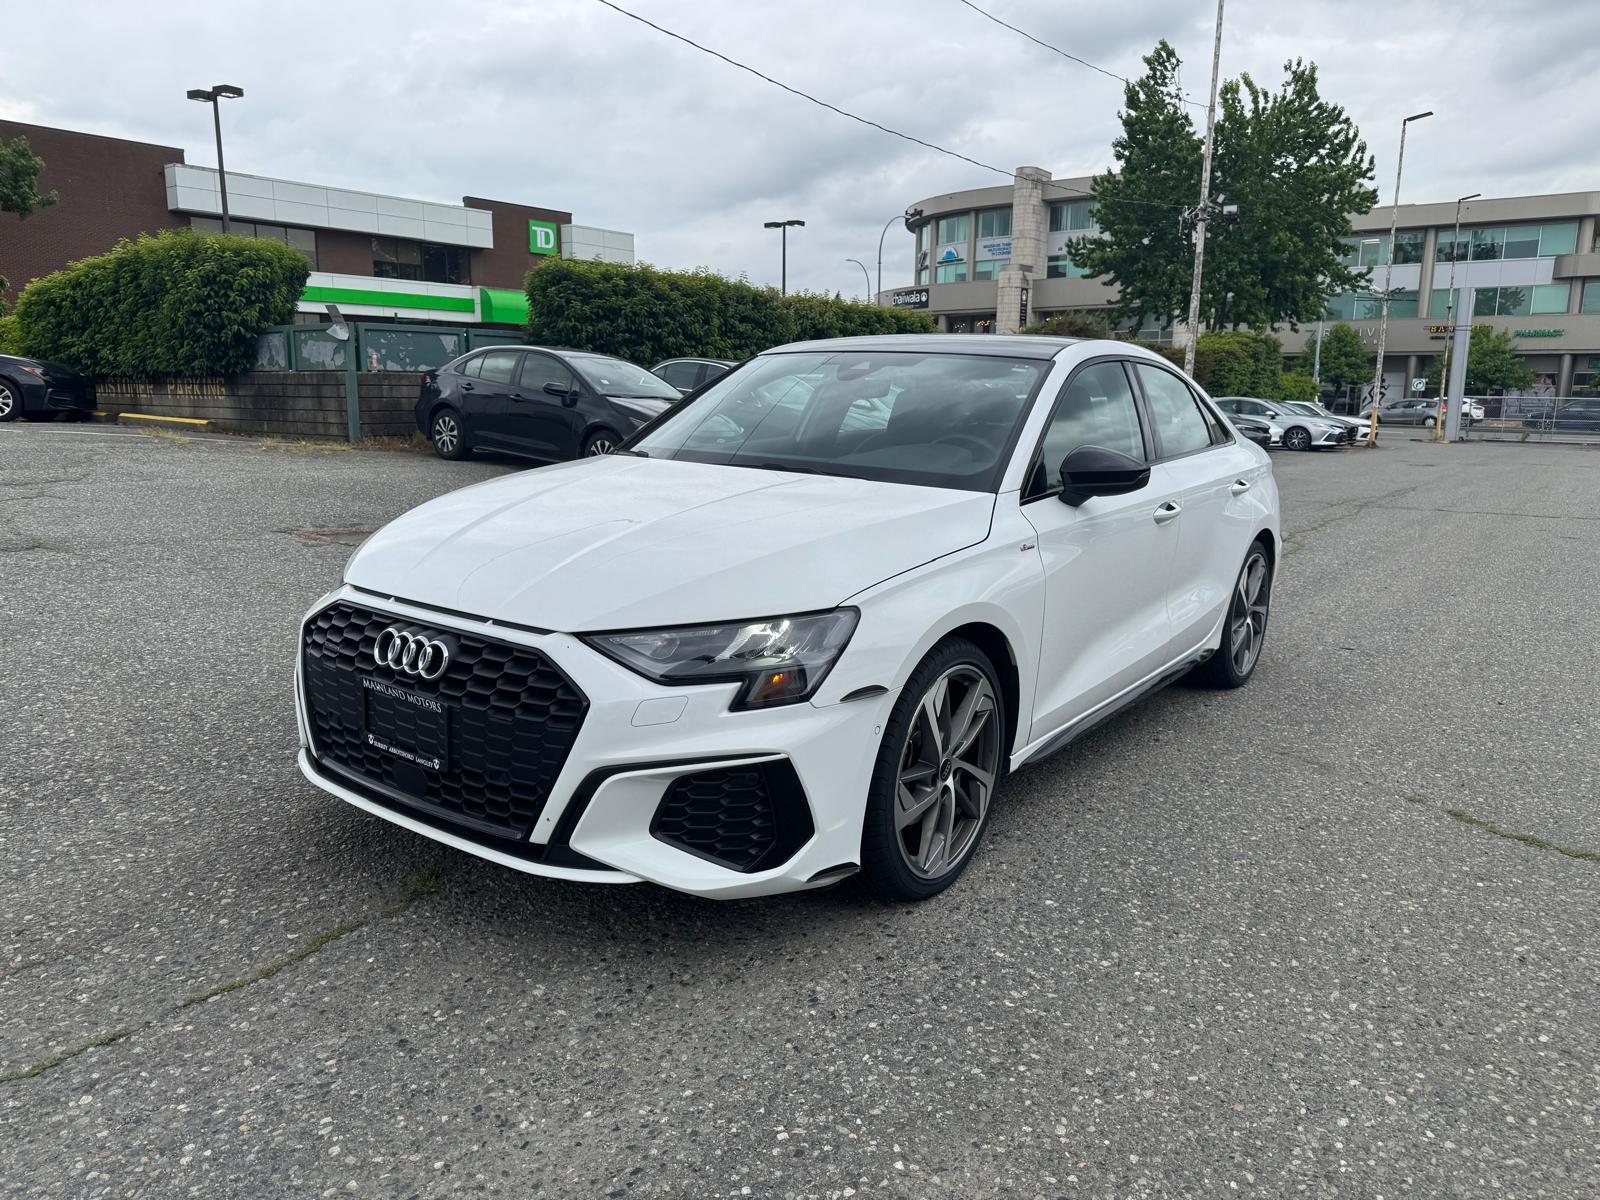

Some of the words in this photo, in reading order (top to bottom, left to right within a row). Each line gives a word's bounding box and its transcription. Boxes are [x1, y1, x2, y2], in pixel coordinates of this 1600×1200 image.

[532, 226, 554, 248] TD
[167, 377, 225, 400] PARKING
[363, 678, 406, 700] MAINLAND
[406, 692, 442, 713] MOTORS
